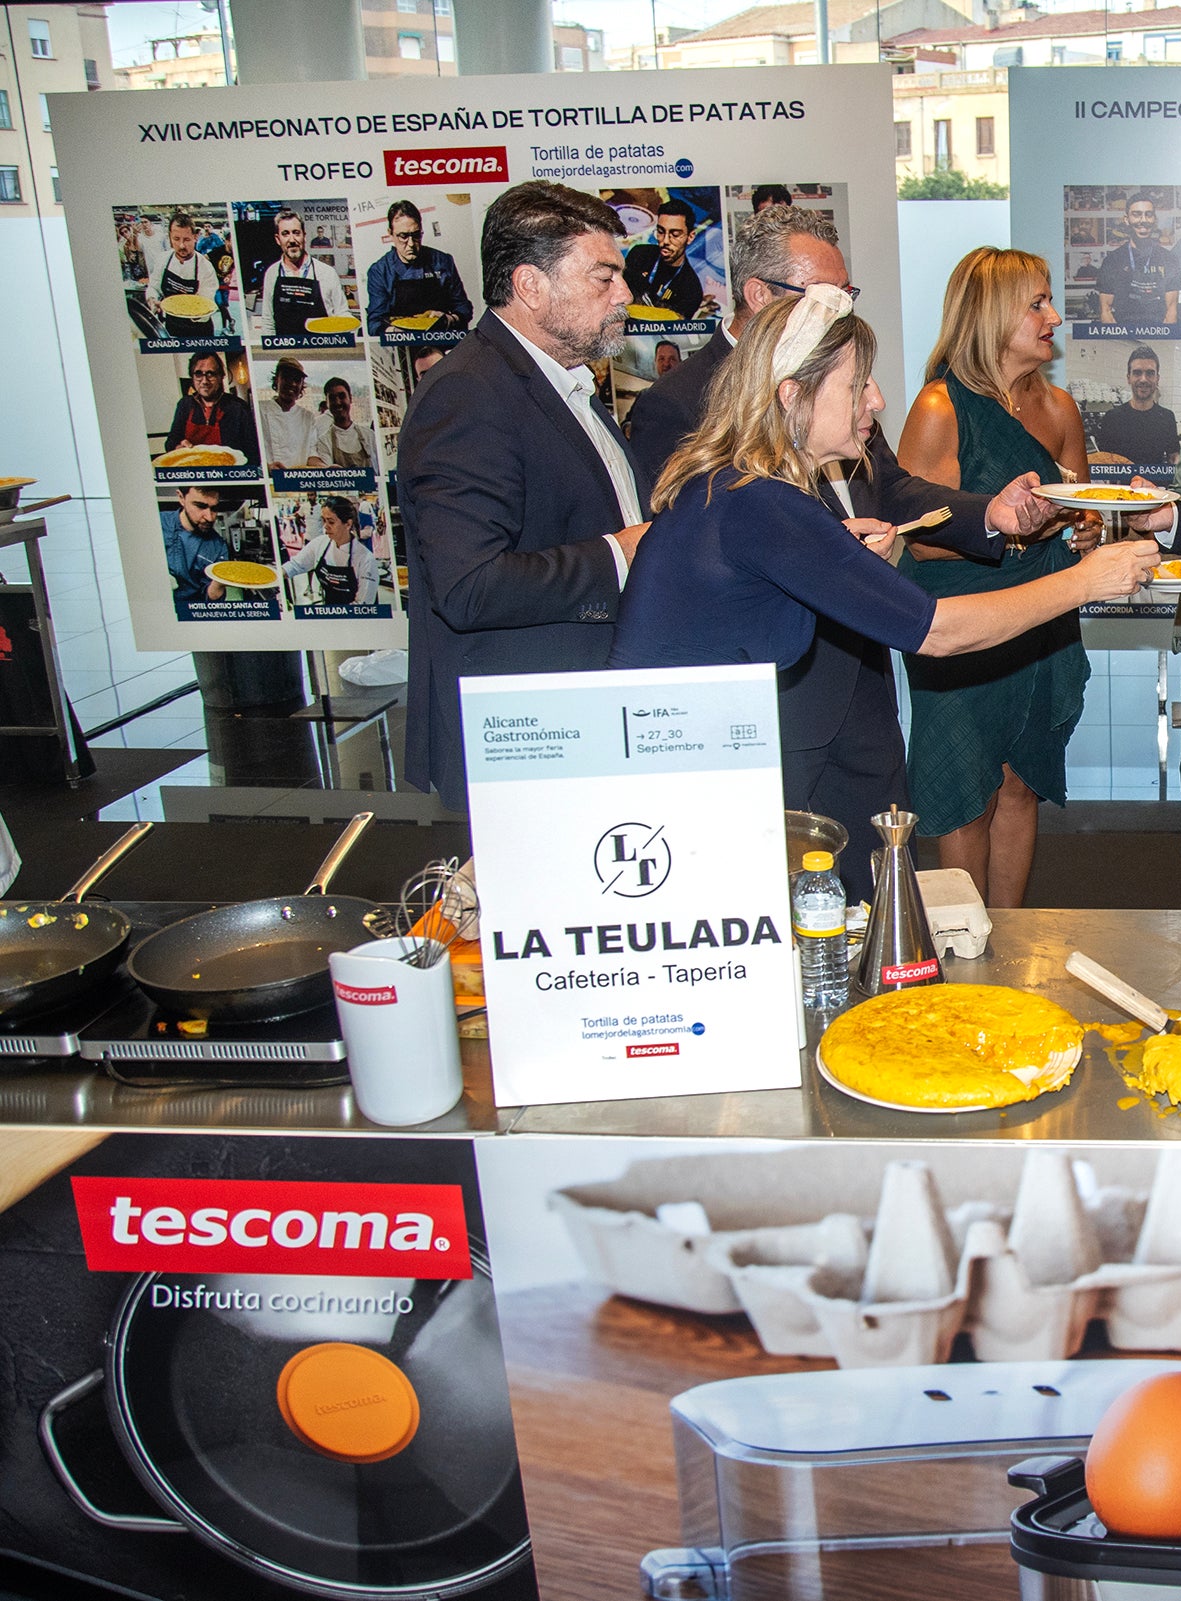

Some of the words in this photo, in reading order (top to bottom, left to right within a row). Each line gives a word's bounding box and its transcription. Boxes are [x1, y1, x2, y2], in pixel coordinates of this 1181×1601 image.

[1075, 101, 1085, 119] II
[138, 124, 181, 142] XVII
[186, 116, 351, 140] CAMPEONATO
[356, 115, 387, 134] DE
[392, 107, 488, 132] ESPAÑA
[492, 110, 524, 129] DE
[528, 106, 647, 127] TORTILLA
[652, 104, 684, 123] DE
[689, 100, 806, 121] PATATAS
[531, 146, 579, 161] Tortilla
[585, 145, 604, 160] de
[608, 144, 664, 160] patatas
[277, 161, 373, 181] TROFEO
[628, 324, 638, 332] LA
[640, 323, 666, 332] FALDA
[673, 322, 706, 332] MADRID
[1088, 327, 1099, 335] LA
[1102, 327, 1128, 336] FALDA
[1136, 327, 1170, 336] MADRID
[186, 338, 230, 347] SANTANDER
[264, 338, 271, 346] O
[273, 338, 295, 346] CABO
[302, 338, 310, 346] A
[312, 334, 348, 346] CORUÑA
[385, 333, 416, 343] TIZONA
[158, 471, 165, 480] EL
[166, 468, 192, 480] CASERÍO
[192, 470, 202, 479] DE
[202, 468, 223, 479] TIÓN
[228, 468, 257, 478] COIRÓS
[284, 470, 321, 479] KAPADOKIA
[322, 470, 366, 478] GASTROBAR
[1091, 466, 1132, 474] ESTRELLAS
[1140, 465, 1176, 474] BASAURI
[300, 480, 314, 488] SAN
[314, 478, 356, 488] SEBASTIÁN
[228, 610, 236, 618] DE
[237, 610, 244, 618] LA
[246, 610, 270, 618] SERENA
[304, 607, 314, 616] LA
[314, 606, 348, 615] TEULADA
[354, 606, 378, 614] ELCHE
[1089, 606, 1134, 614] CONCORDIA
[652, 708, 670, 718] IFA
[483, 716, 538, 729] Alicante
[484, 727, 580, 743] Gastronómica
[636, 743, 704, 754] Septiembre
[493, 929, 552, 961] LA
[565, 916, 782, 956] TEULADA
[536, 966, 640, 992] Cafetería
[662, 960, 748, 987] Tapería
[581, 1016, 619, 1028] Tortilla
[623, 1016, 638, 1026] de
[641, 1014, 684, 1026] patatas
[152, 1284, 260, 1310] Disfruta
[268, 1290, 414, 1315] cocinando
